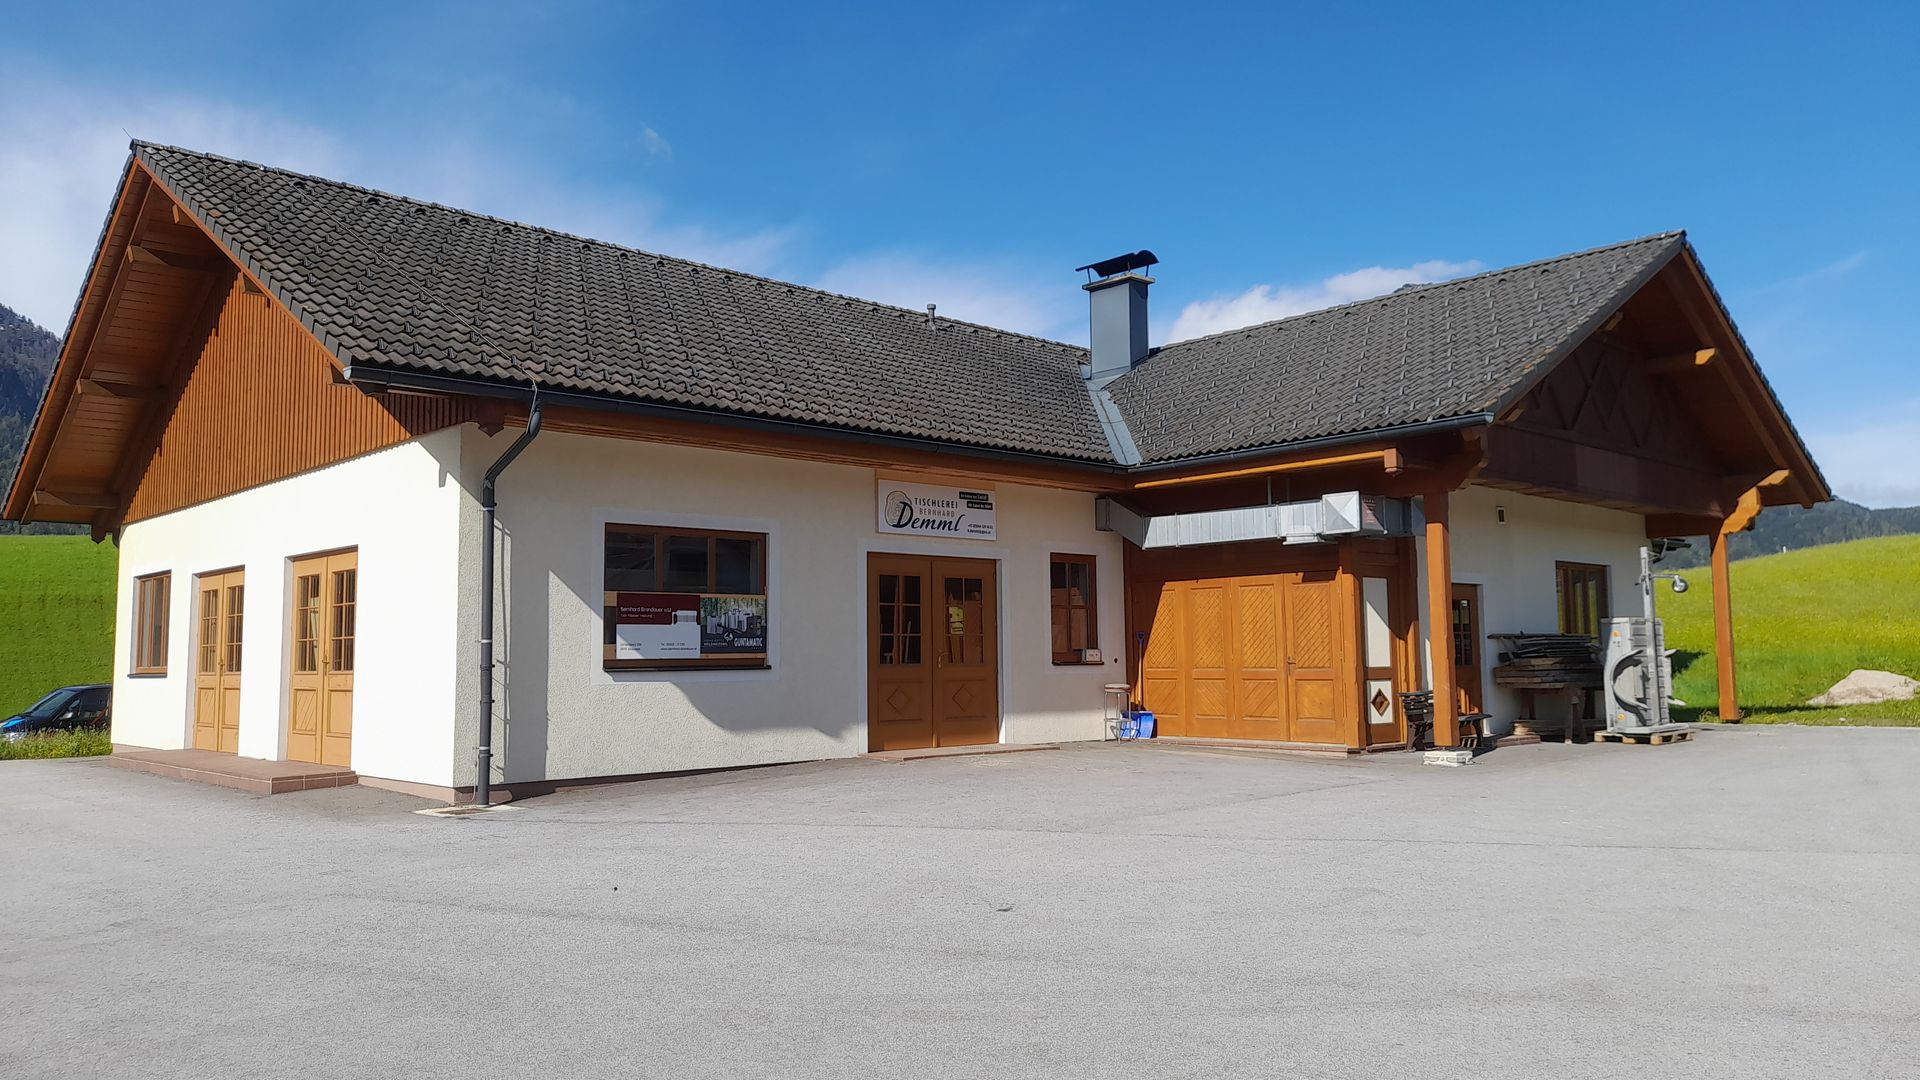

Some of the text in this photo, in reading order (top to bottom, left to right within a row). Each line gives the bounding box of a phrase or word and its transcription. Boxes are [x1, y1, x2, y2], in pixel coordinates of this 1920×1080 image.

[914, 497, 958, 509] TISCHLEREI
[891, 501, 966, 532] Demml
[919, 507, 955, 518] BERNHARD
[734, 637, 763, 647] GUNTAMATIC
